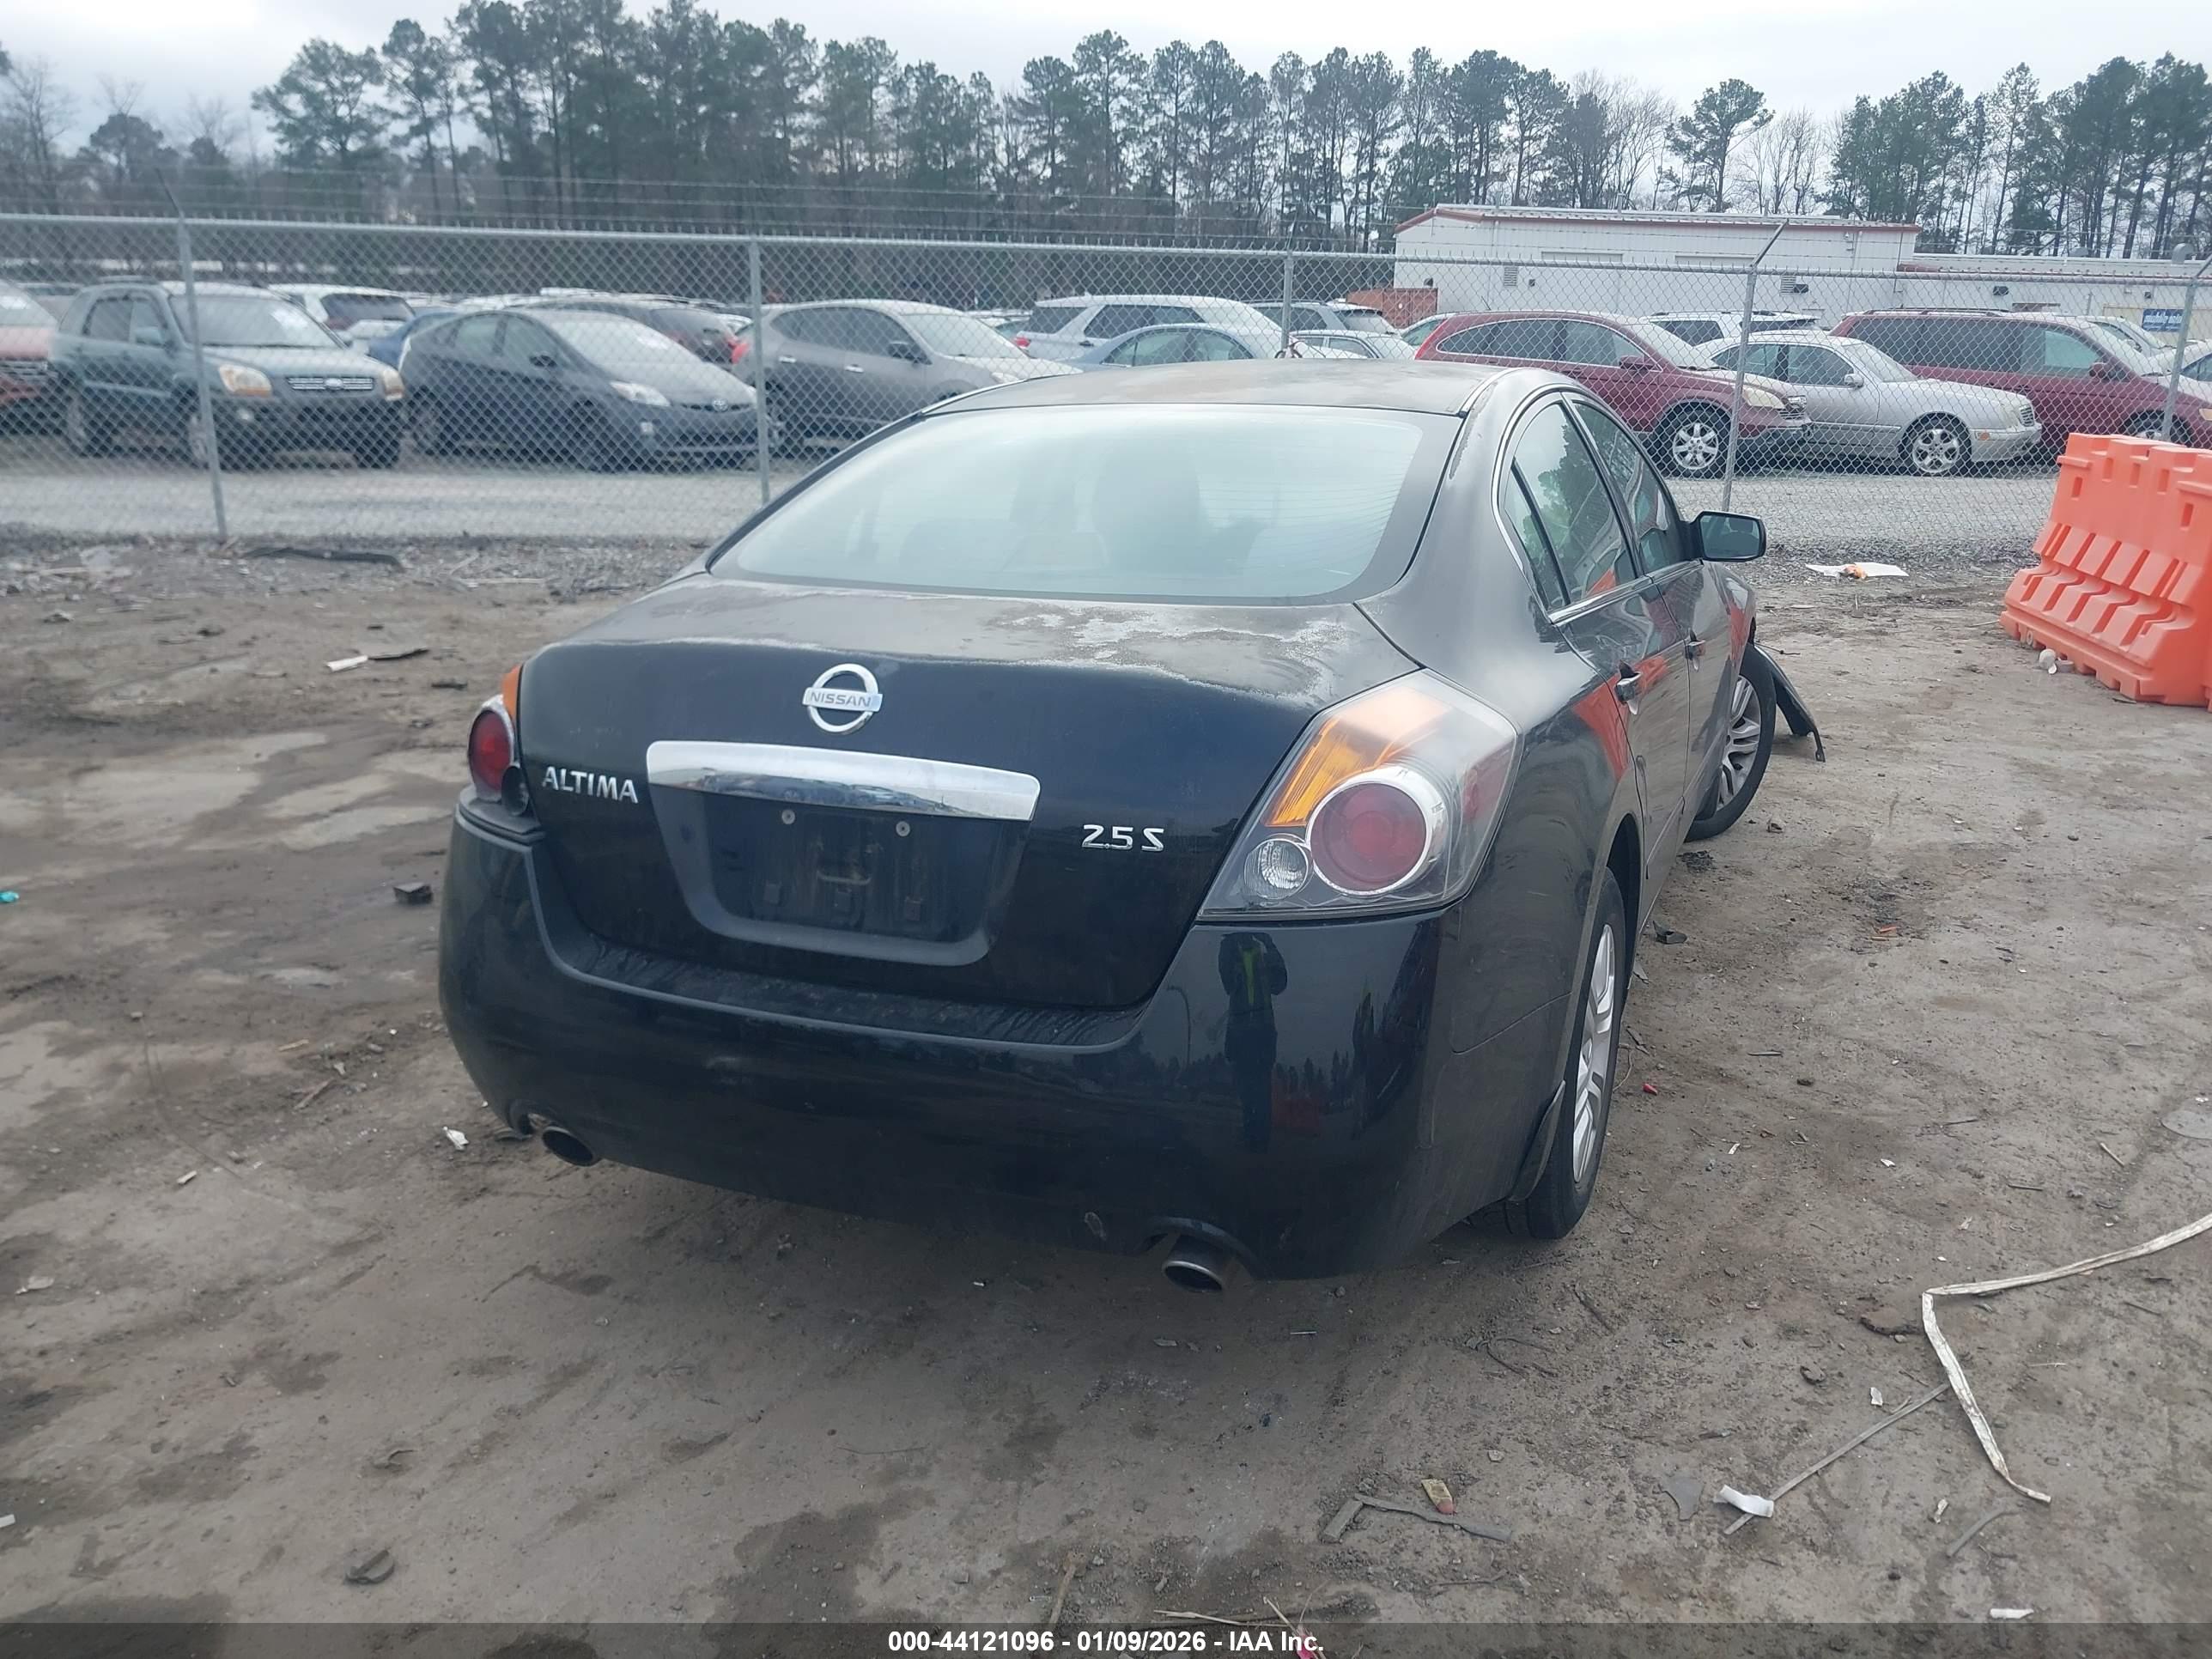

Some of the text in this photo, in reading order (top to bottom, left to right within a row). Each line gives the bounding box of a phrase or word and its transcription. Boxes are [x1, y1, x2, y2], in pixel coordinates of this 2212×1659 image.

[810, 691, 872, 708] NISSAN
[542, 766, 639, 804] ALTIMA
[1082, 824, 1164, 851] 2.5 S
